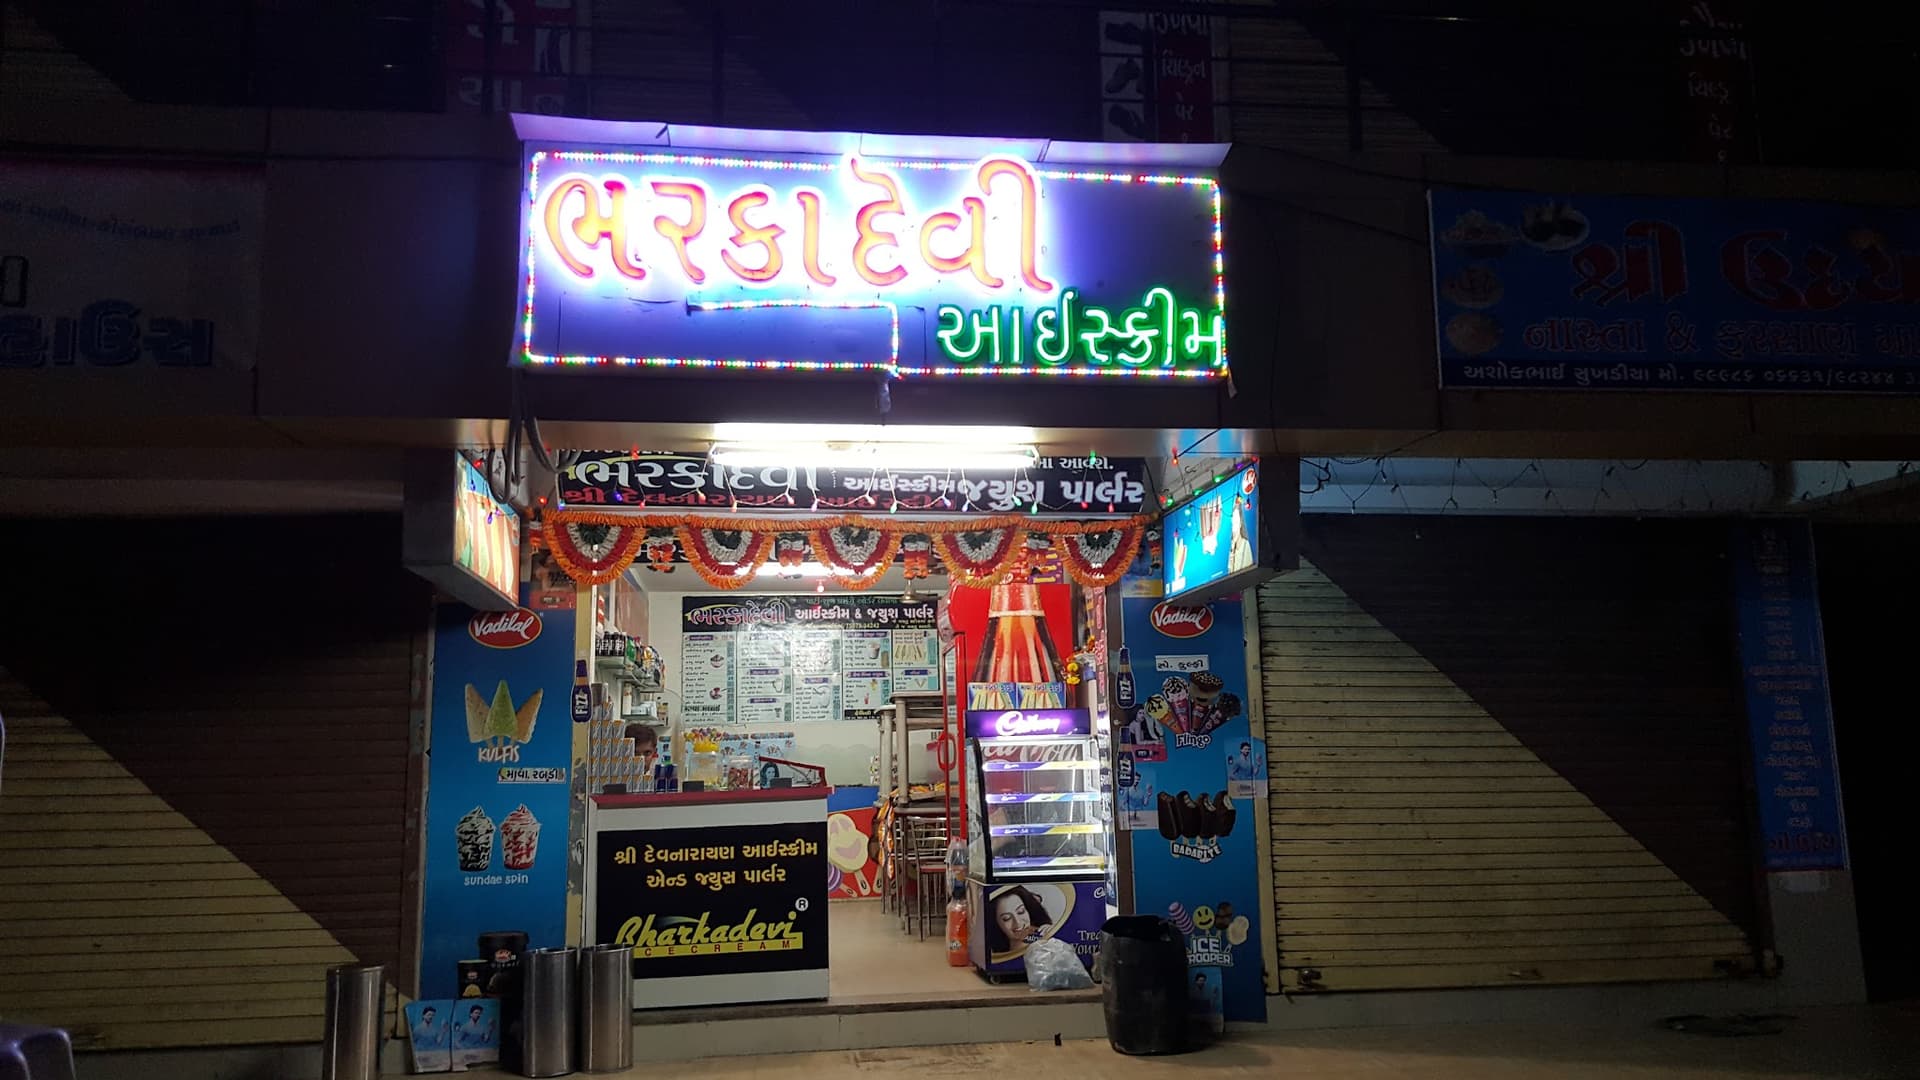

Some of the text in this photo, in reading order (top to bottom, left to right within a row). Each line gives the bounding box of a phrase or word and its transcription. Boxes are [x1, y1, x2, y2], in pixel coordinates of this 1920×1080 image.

[543, 155, 1055, 293] ભરકાદેવી
[473, 613, 534, 640] Vadilal
[1154, 605, 1206, 630] Vadilal
[643, 844, 735, 864] દેવનારાયણ
[1192, 937, 1220, 954] ICE
